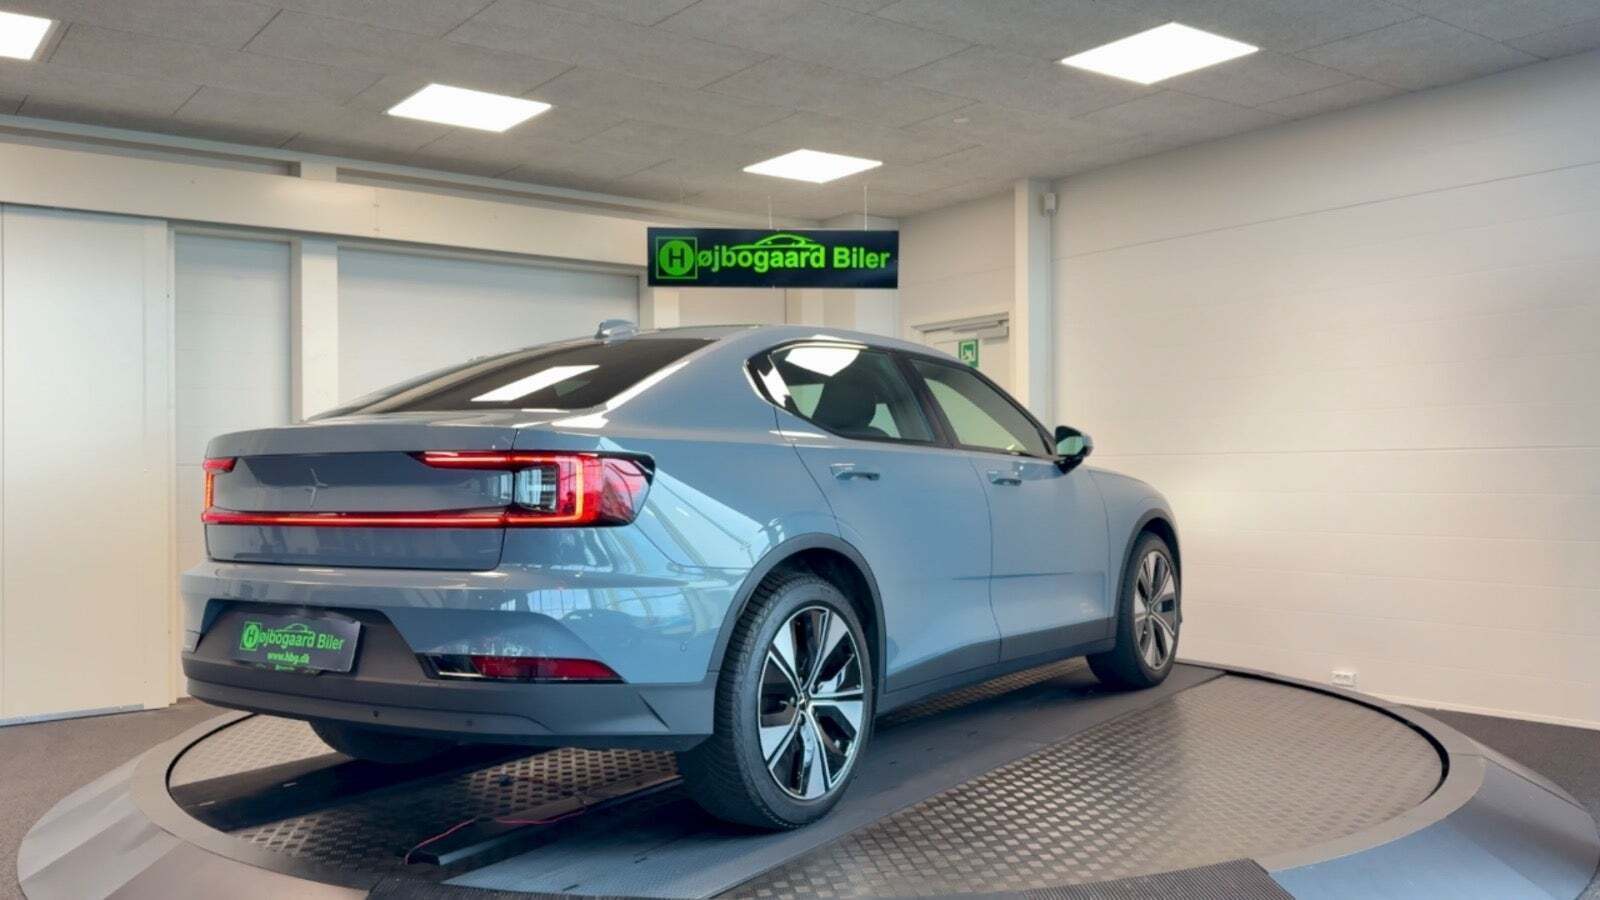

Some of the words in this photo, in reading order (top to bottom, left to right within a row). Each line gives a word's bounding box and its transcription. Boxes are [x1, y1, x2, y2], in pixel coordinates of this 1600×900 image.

[659, 240, 826, 275] Højbogaard
[833, 246, 891, 269] Biler
[317, 633, 345, 650] Biler
